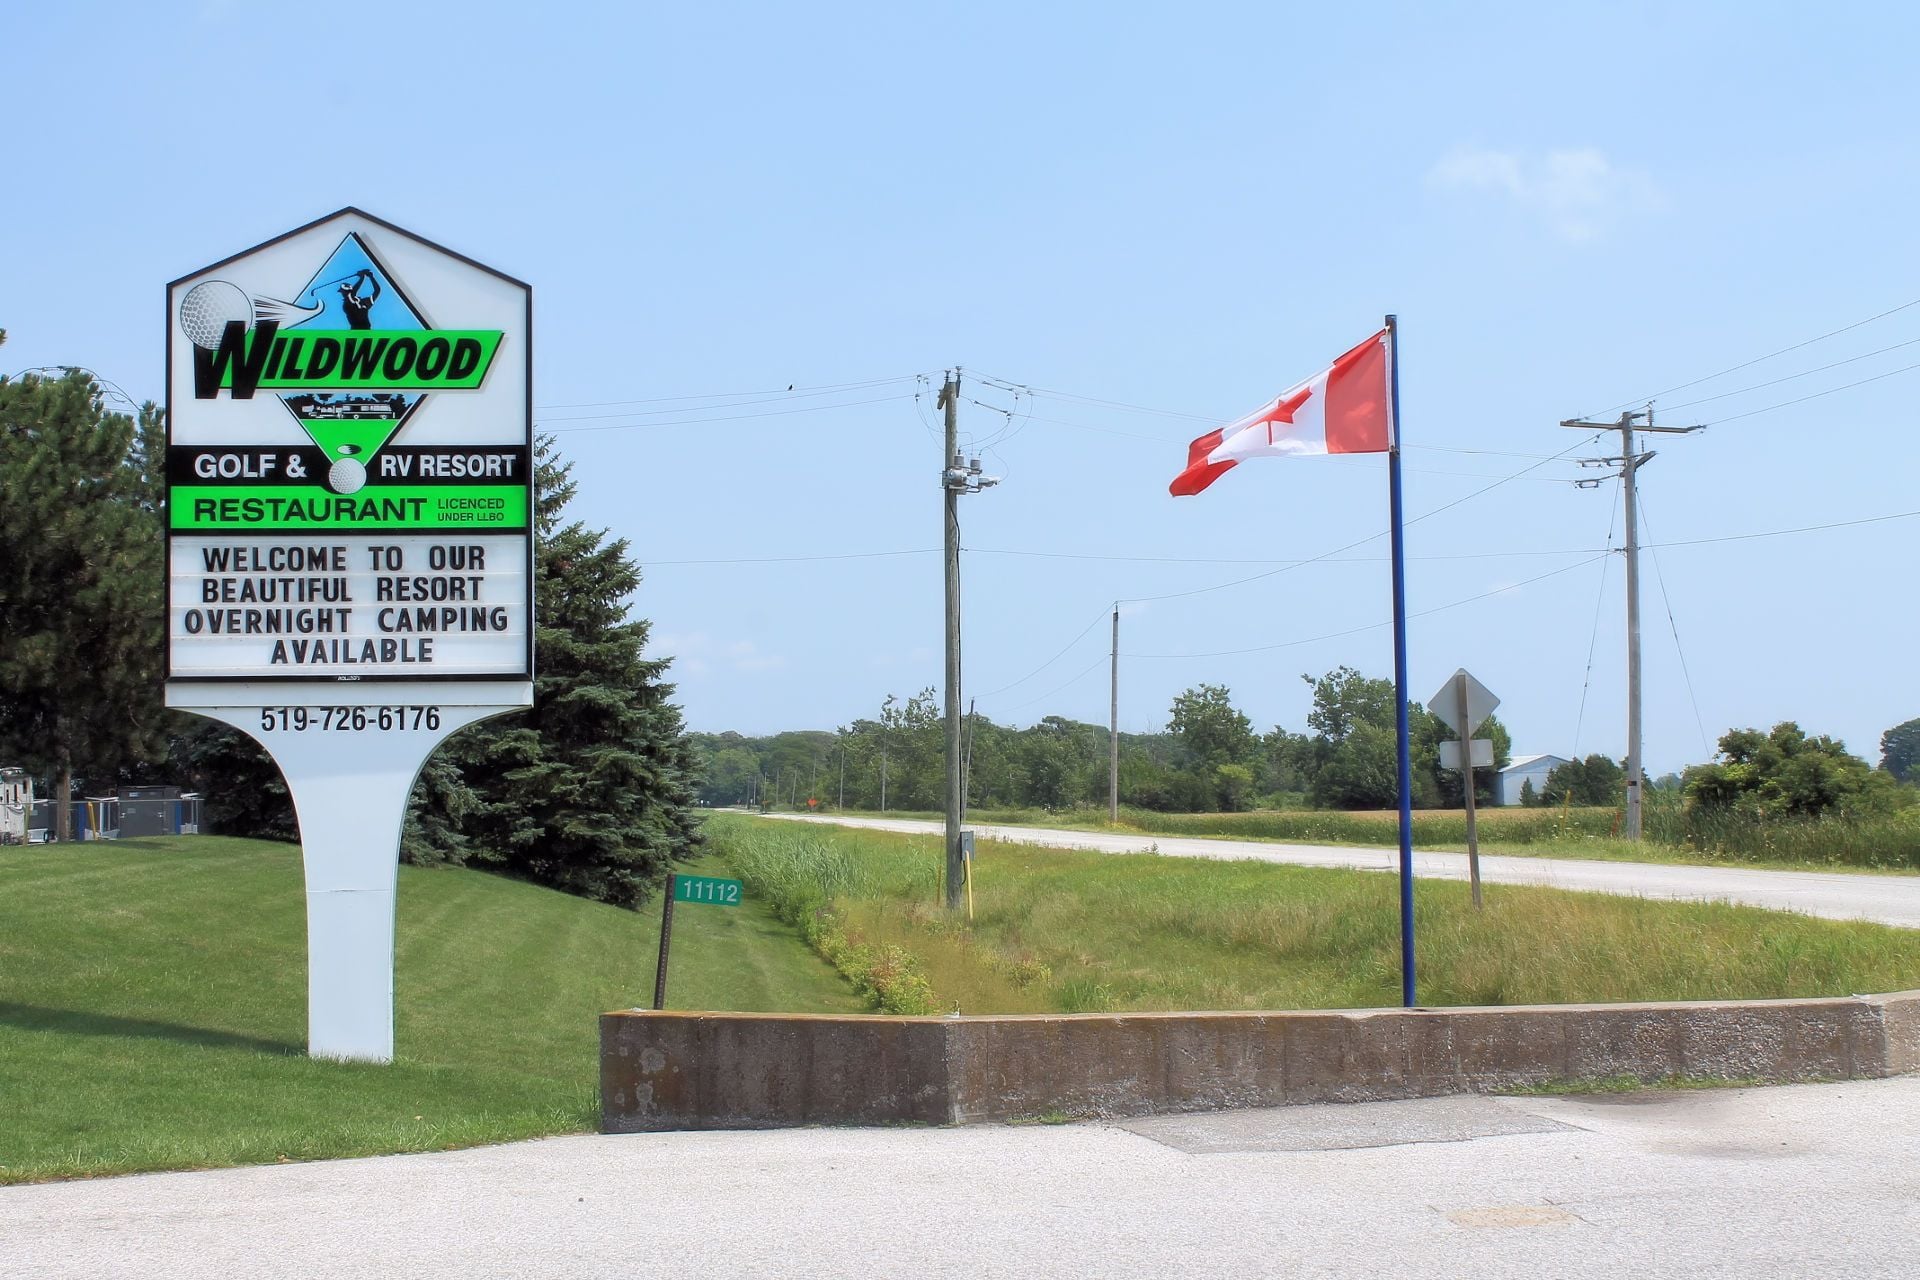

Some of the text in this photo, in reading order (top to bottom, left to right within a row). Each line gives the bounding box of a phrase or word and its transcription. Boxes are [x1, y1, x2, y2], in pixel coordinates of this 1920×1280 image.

[194, 321, 482, 399] WILDWOOD
[194, 454, 516, 479] GOLF & RV RESORT
[194, 498, 427, 522] RESTAURANT
[437, 498, 505, 509] LICENCED
[437, 512, 505, 521] UNDER LLBO
[203, 545, 485, 572] WELCOME TO OUR
[202, 576, 484, 603] BEAUTIFUL RESORT
[184, 607, 508, 634] OVERNIGHT CAMPING
[271, 638, 433, 664] AVAILABLE
[261, 706, 440, 732] 519-726-6176
[684, 880, 738, 901] 11112
